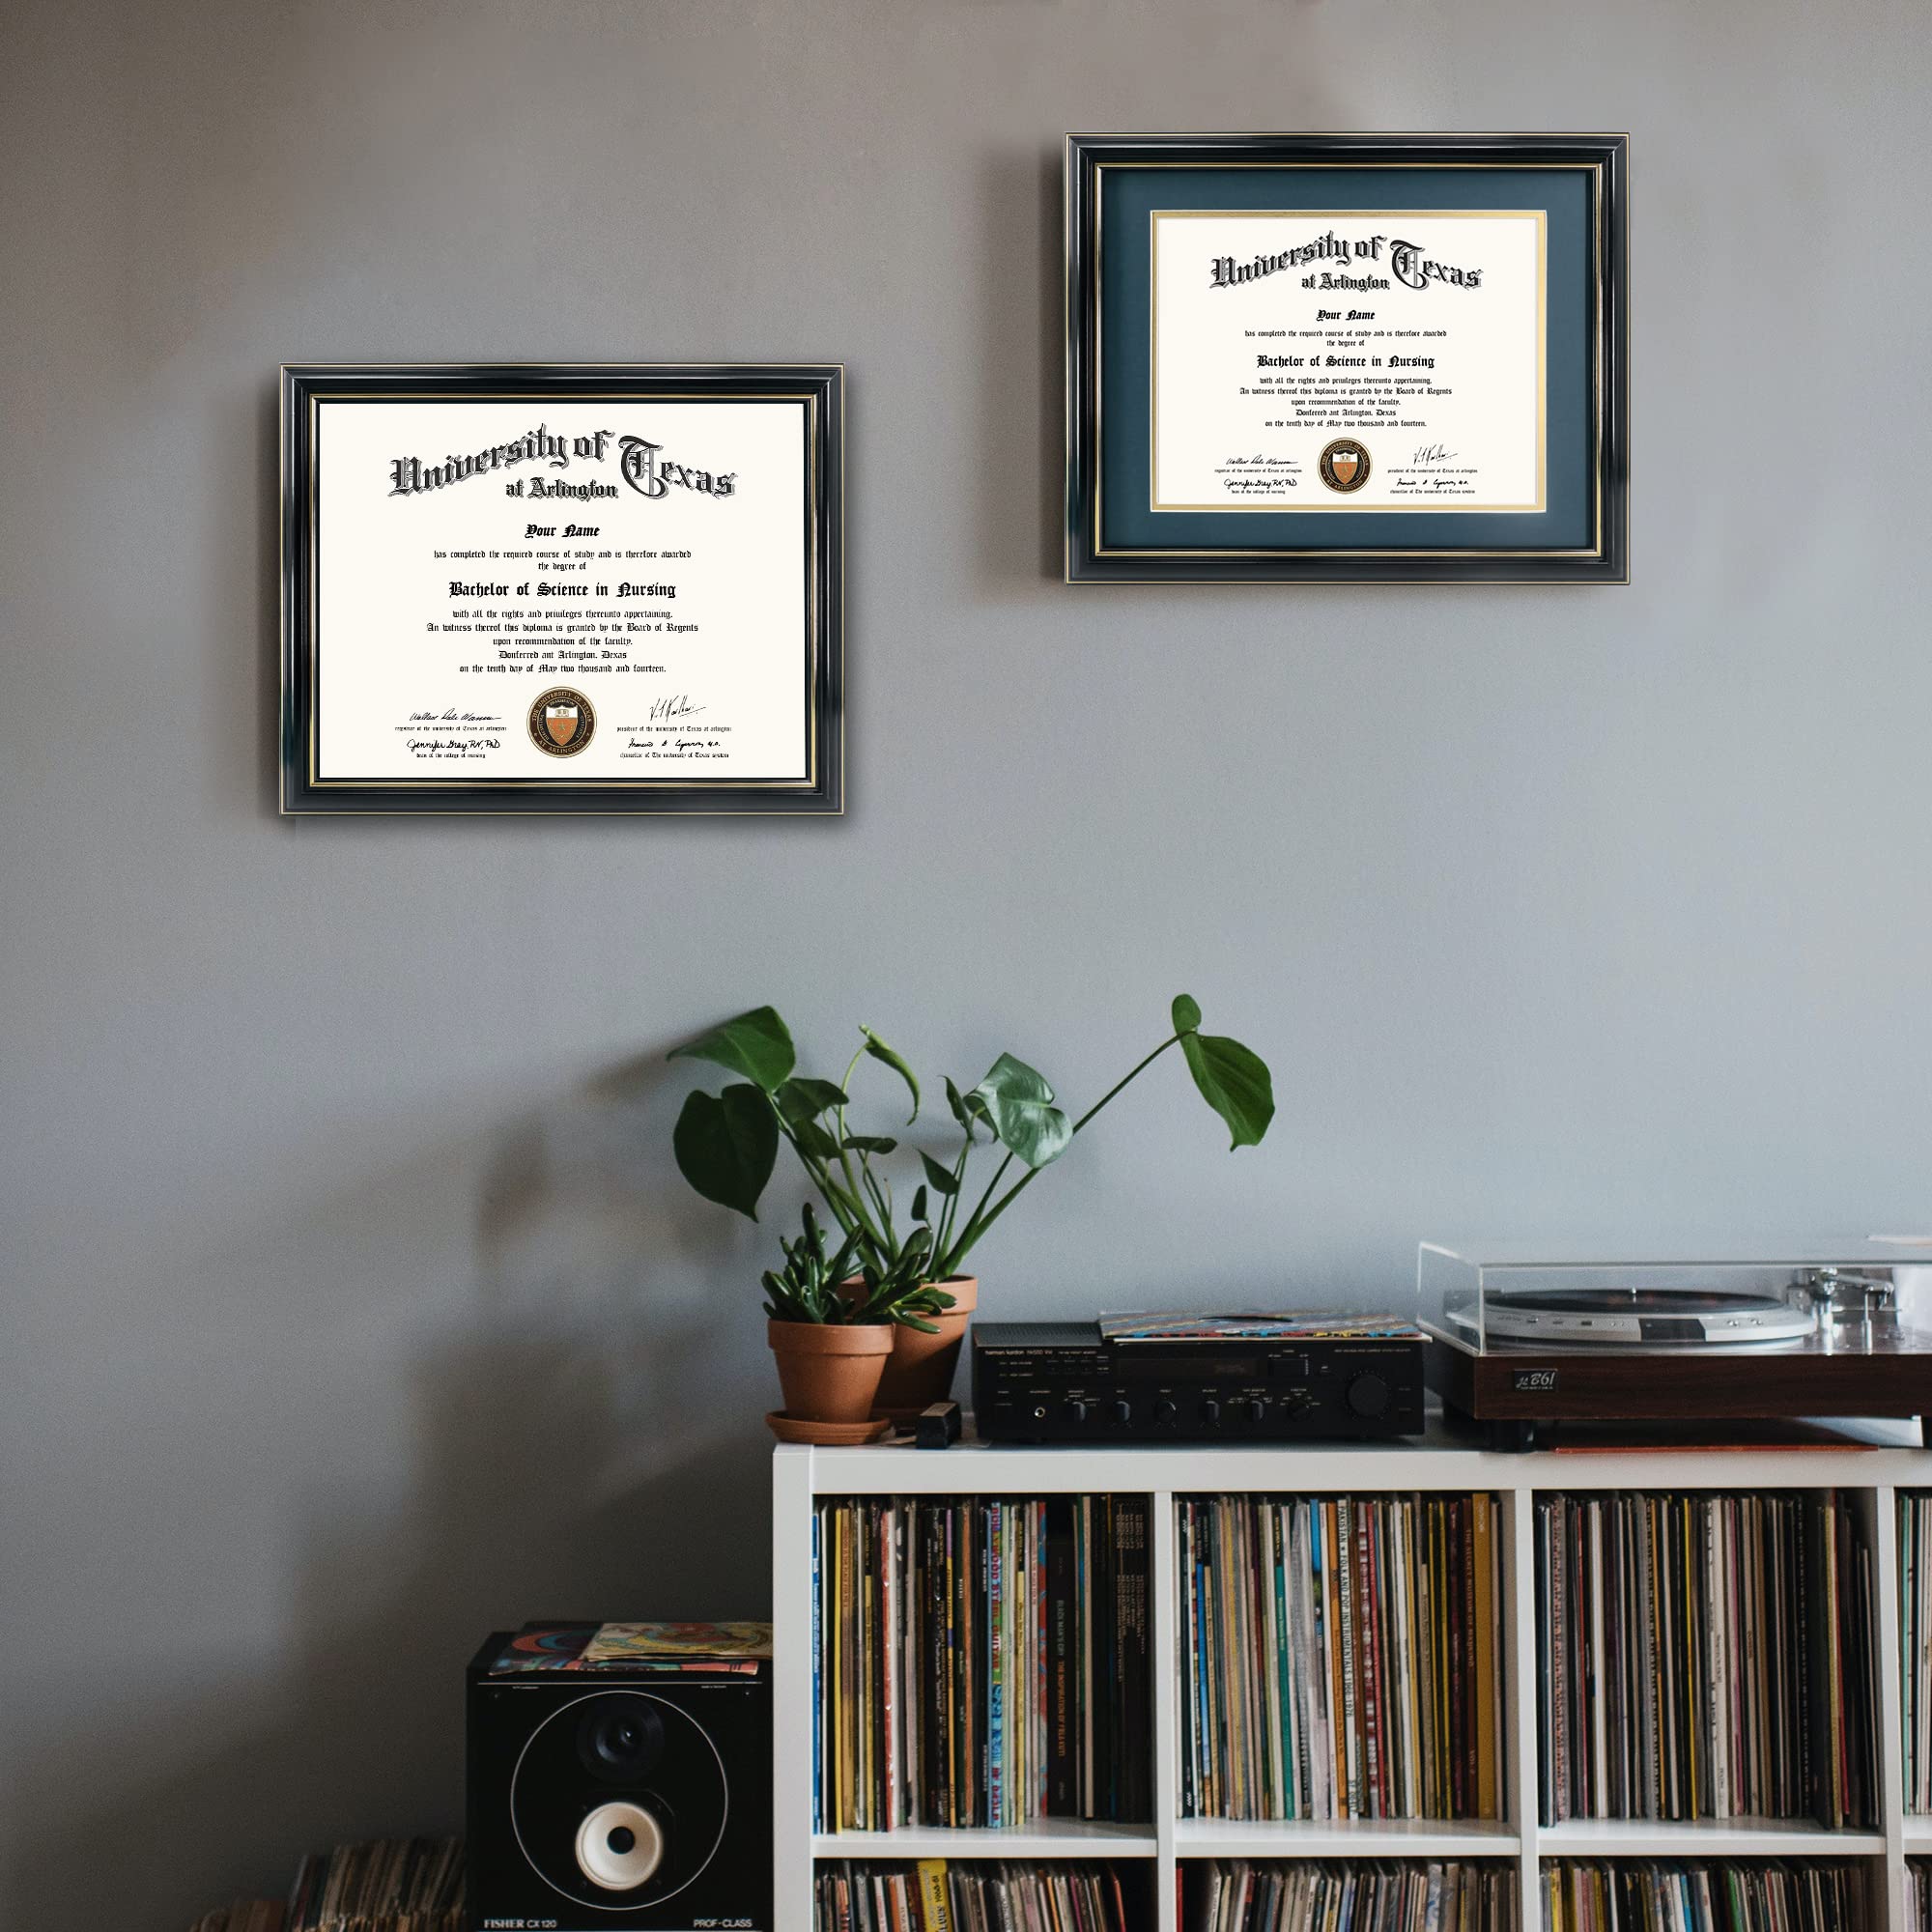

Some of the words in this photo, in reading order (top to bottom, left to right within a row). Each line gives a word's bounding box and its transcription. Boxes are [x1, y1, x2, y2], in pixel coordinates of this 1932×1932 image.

[1209, 230, 1351, 288] University
[1354, 235, 1387, 260] of
[1389, 240, 1484, 291] Texas
[1301, 274, 1316, 288] at
[1319, 272, 1389, 293] Arlington
[1316, 309, 1342, 322] Your
[1346, 310, 1375, 321] Name
[1257, 355, 1304, 368] Bachelor
[1310, 355, 1320, 366] of
[1325, 355, 1366, 367] Science
[1372, 355, 1381, 366] in
[1387, 355, 1435, 369] Nursing
[1298, 377, 1316, 385] rights
[1349, 387, 1372, 396] granted
[1427, 386, 1452, 396] Regents
[1378, 398, 1401, 407] faculty.
[1326, 419, 1342, 428] May
[387, 422, 570, 497] University
[573, 429, 615, 462] of
[618, 435, 738, 499] Texas
[505, 477, 524, 497] at
[526, 476, 619, 502] Arlington
[525, 524, 556, 539] Your
[561, 524, 600, 537] Name
[451, 551, 485, 559] completed
[503, 551, 532, 559] required
[575, 551, 594, 559] study
[538, 562, 549, 571] the
[553, 562, 576, 571] degree
[449, 582, 509, 598] Bachelor
[517, 582, 529, 596] of
[537, 582, 588, 596] Science
[596, 582, 608, 596] in
[615, 582, 676, 598] Nursing
[452, 609, 469, 618] with
[487, 610, 497, 619] the
[501, 610, 524, 619] rights
[527, 609, 542, 617] and
[585, 610, 620, 620] thereunto
[475, 623, 500, 632] thereof
[504, 623, 519, 633] this
[523, 624, 553, 633] diploma
[567, 624, 595, 633] granted
[600, 624, 608, 633] by
[611, 623, 622, 632] the
[627, 623, 651, 633] Board
[667, 623, 698, 633] Regents
[579, 637, 586, 645] of
[590, 637, 601, 646] the
[605, 637, 633, 646] faculty.
[472, 665, 483, 673] the
[487, 665, 505, 673] tenth
[509, 665, 523, 673] day
[578, 665, 611, 673] thousand
[1338, 1506, 1347, 1543] PAKISTAN
[1343, 1612, 1352, 1674] INSTRUMENTALS
[992, 1625, 1001, 1669] GUITAR
[484, 1919, 525, 1929] FISHER
[526, 1919, 540, 1929] CX
[541, 1919, 557, 1929] 120
